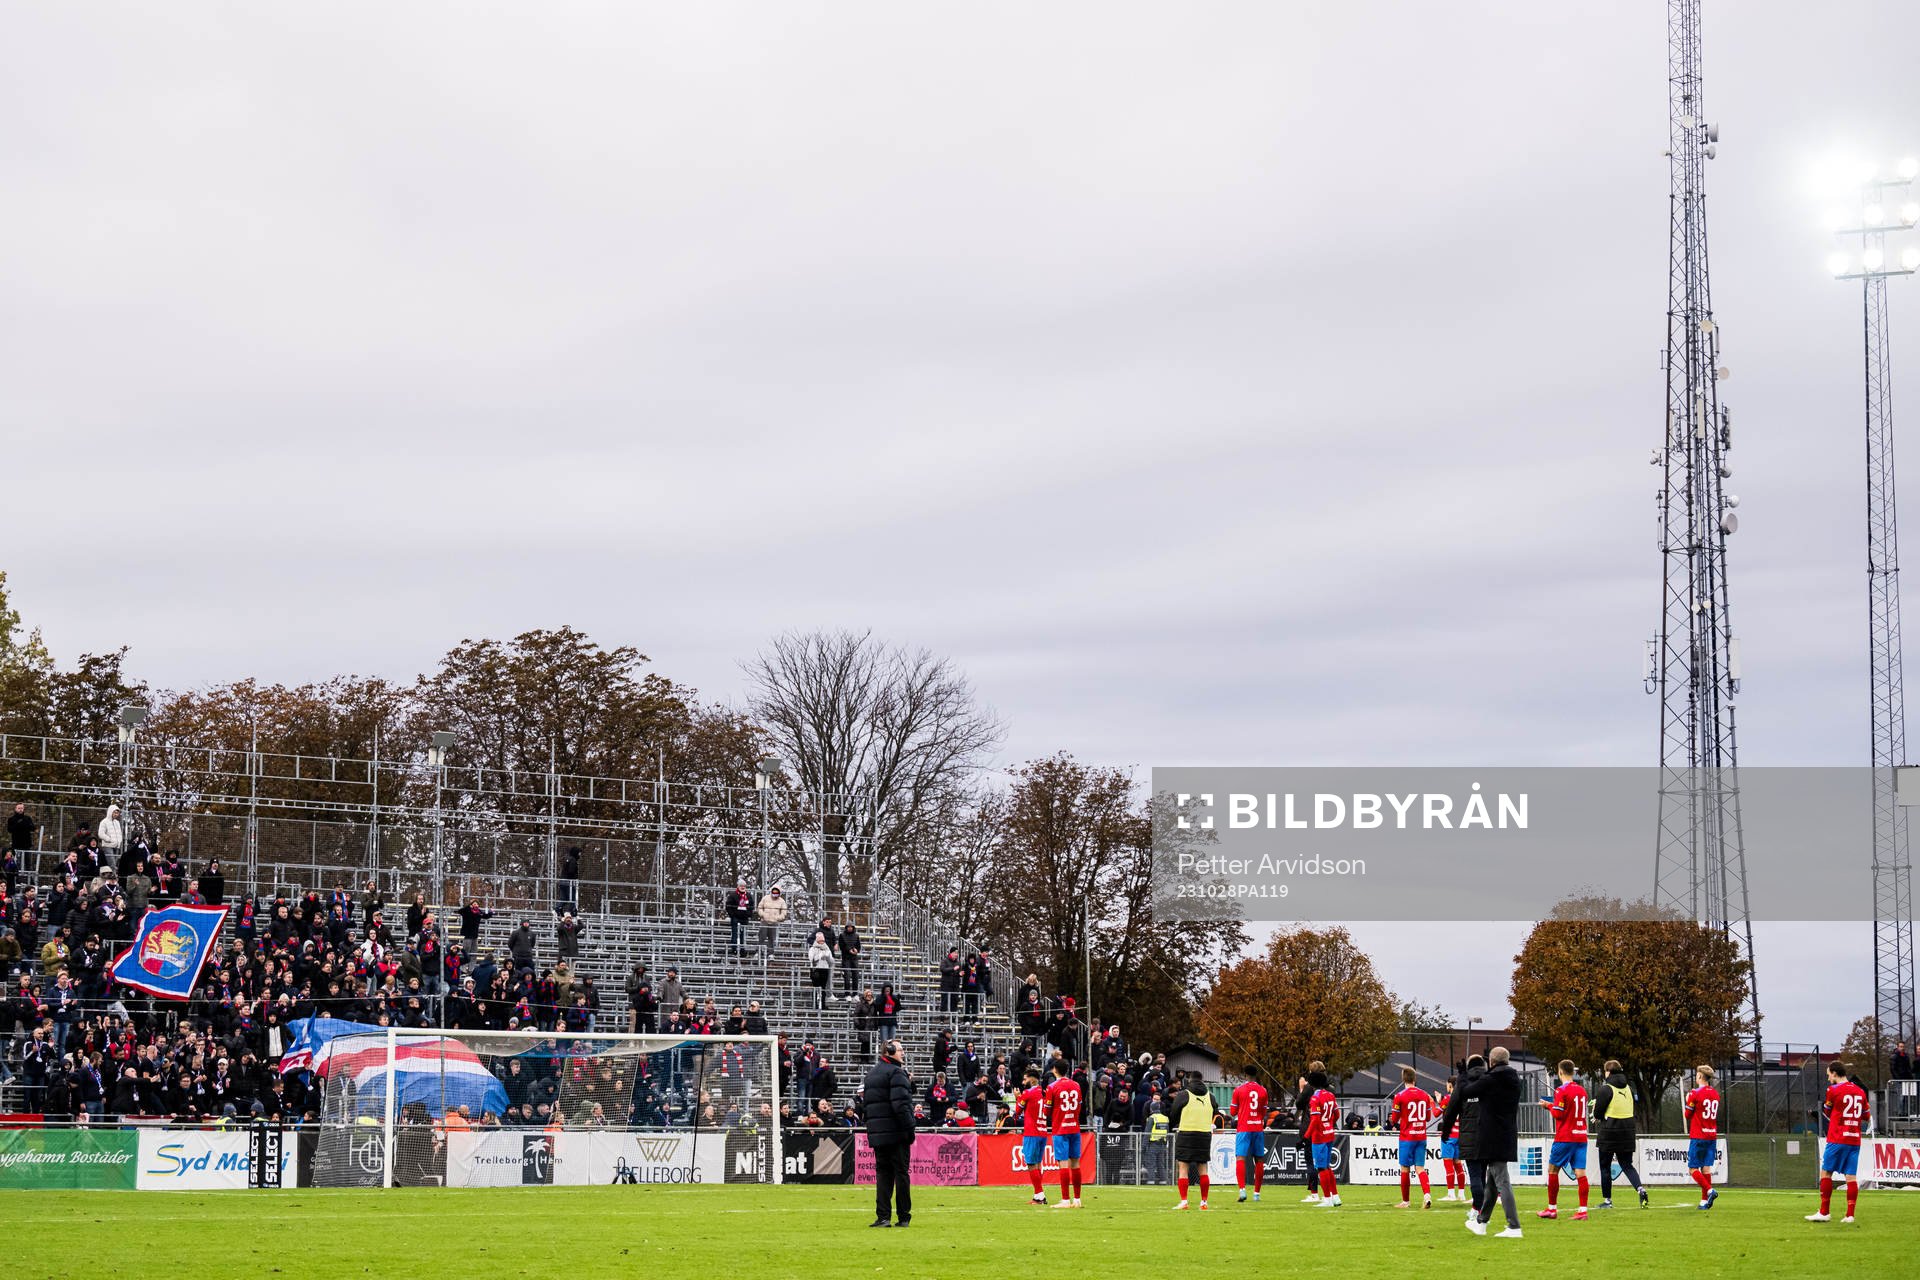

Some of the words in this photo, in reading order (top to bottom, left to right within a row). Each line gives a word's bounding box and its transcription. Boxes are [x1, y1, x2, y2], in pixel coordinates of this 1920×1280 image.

[1060, 1090, 1079, 1112] 33
[1249, 1090, 1259, 1110] 3
[1321, 1101, 1334, 1121] 27
[1407, 1100, 1427, 1122] 20
[1573, 1095, 1586, 1119] 11
[1702, 1099, 1719, 1120] 39
[1842, 1094, 1863, 1119] 25
[0, 1148, 66, 1168] ygehamn
[69, 1149, 133, 1164] Bostäder
[147, 1144, 213, 1177] Syd
[250, 1130, 259, 1183] SELECT
[265, 1130, 278, 1182] SELECT
[474, 1155, 534, 1167] Trelleborgs
